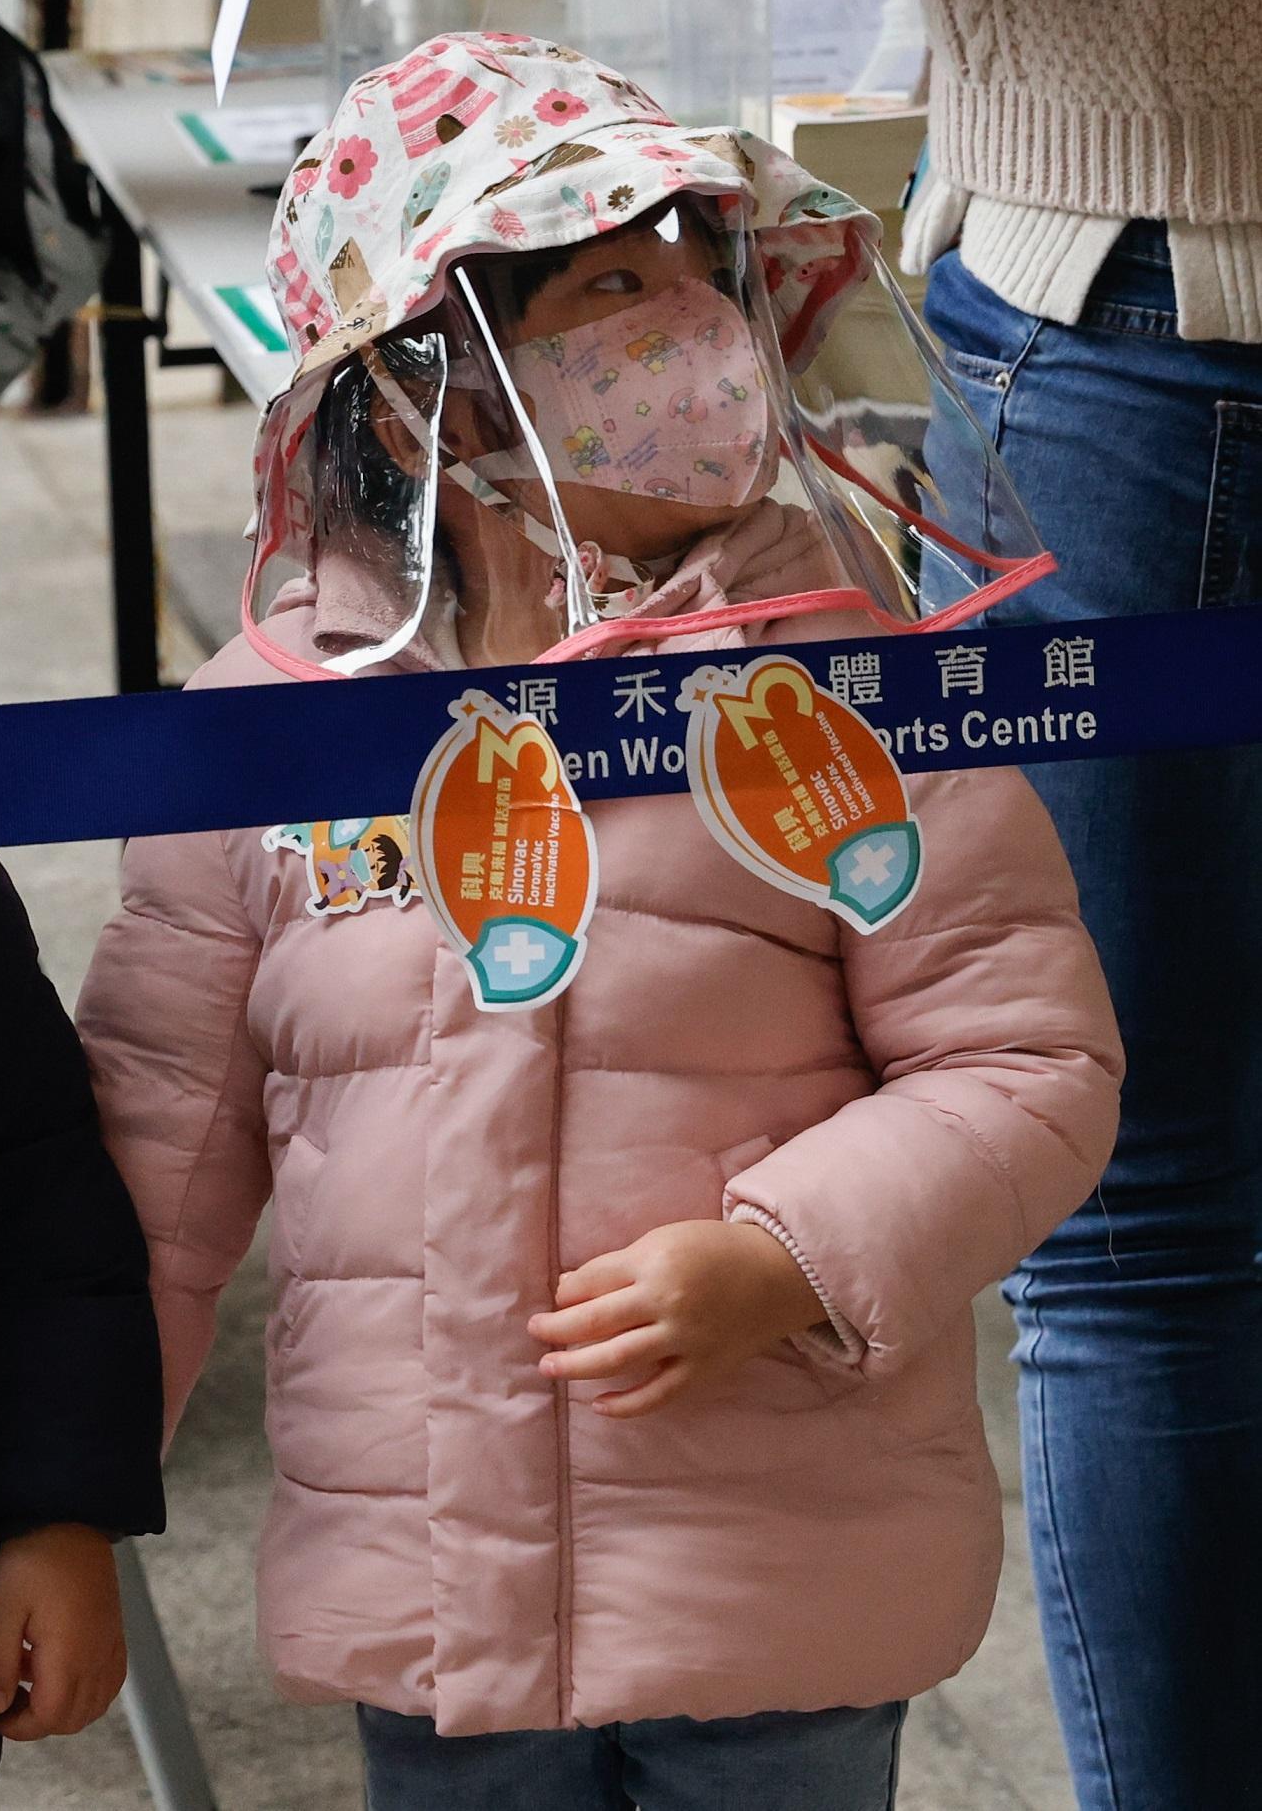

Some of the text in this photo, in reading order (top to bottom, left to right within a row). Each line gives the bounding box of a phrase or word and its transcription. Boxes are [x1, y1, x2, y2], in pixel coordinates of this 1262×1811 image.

[506, 636, 1096, 730] 源禾體育館
[718, 667, 814, 750] 3
[477, 721, 558, 792] 3
[562, 747, 609, 782] en
[621, 737, 685, 776] Wo
[959, 707, 1097, 750] Centre
[816, 711, 876, 813] Inactivated Vaccine
[810, 771, 847, 831] Sinovac
[826, 764, 862, 821] CoronaVac
[461, 851, 486, 902] 科興
[507, 838, 529, 905] Sinovac
[527, 840, 544, 907] CoronaVac
[542, 839, 559, 908] Inactivated
